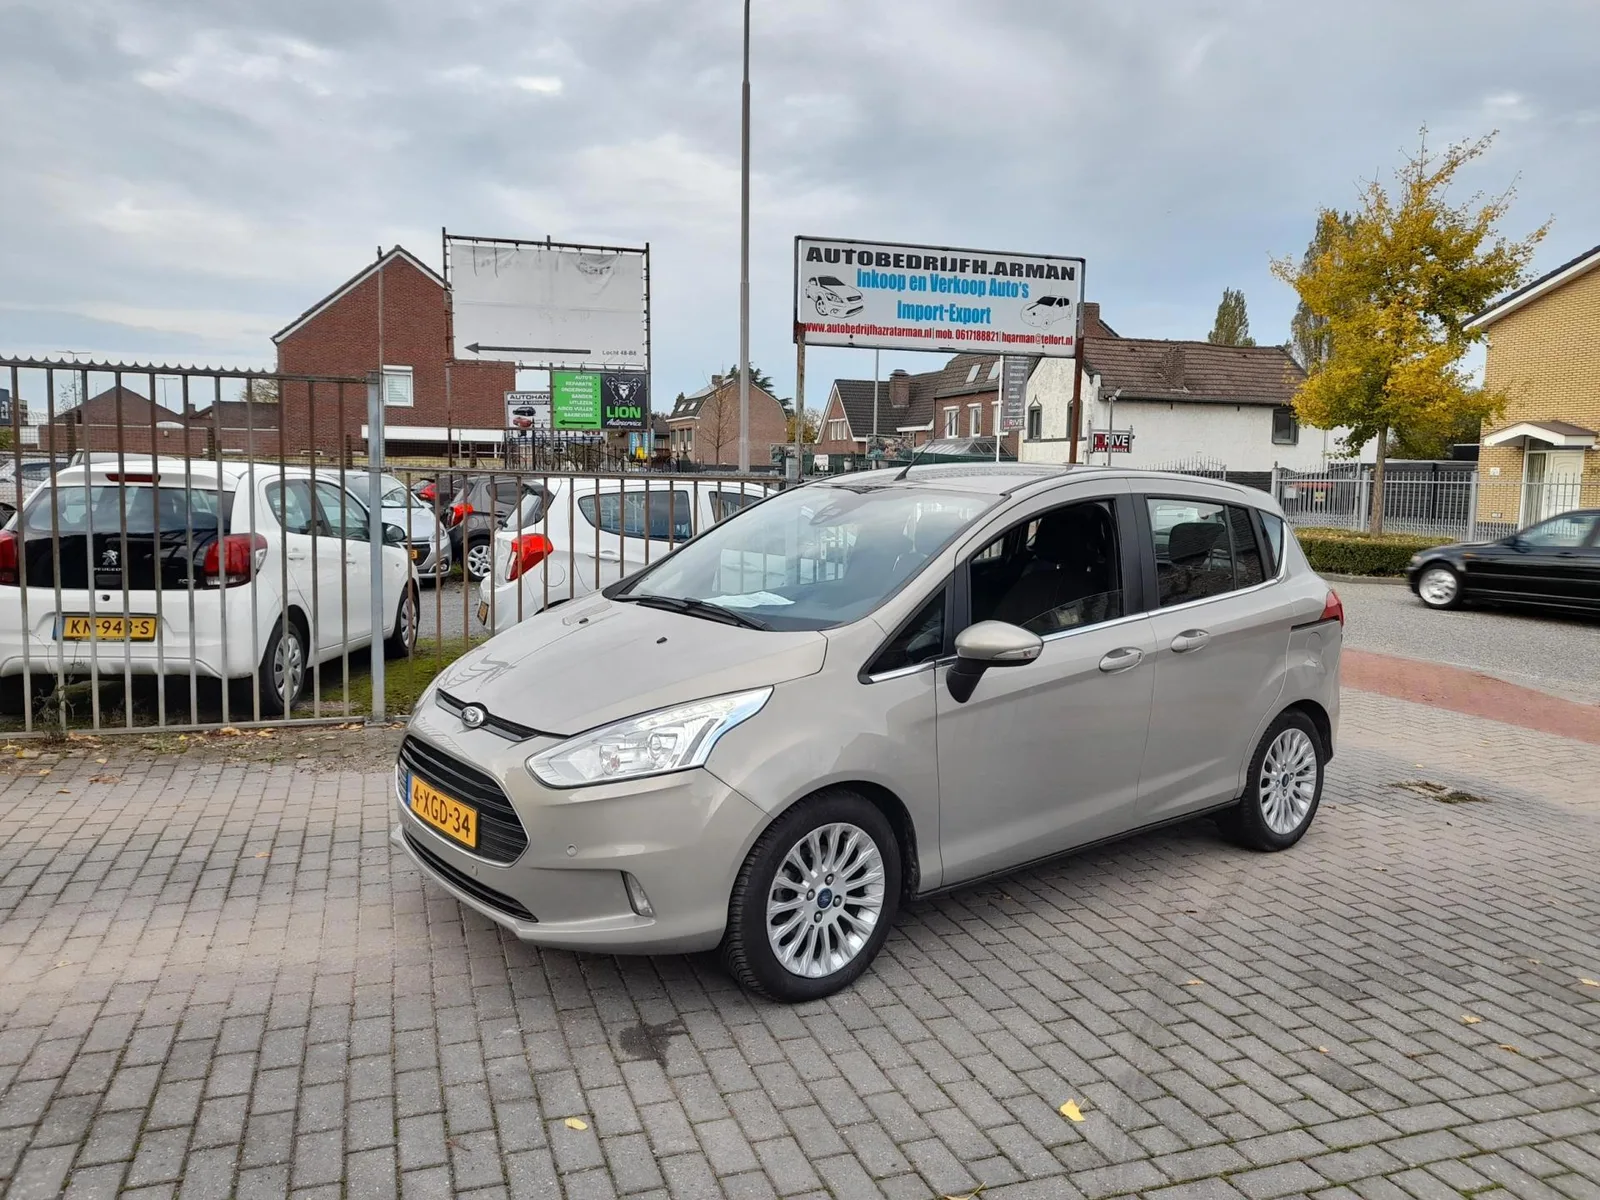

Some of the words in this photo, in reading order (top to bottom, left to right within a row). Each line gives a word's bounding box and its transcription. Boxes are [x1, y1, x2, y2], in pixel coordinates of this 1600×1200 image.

[856, 268, 906, 293] Inkoop
[909, 273, 927, 292] en
[930, 273, 985, 298] Verkoop
[989, 277, 1030, 299] Auto's
[897, 300, 991, 325] Import-Export
[935, 329, 954, 340] mob.
[606, 406, 642, 419] LION
[413, 784, 471, 839] 4-XGD-34
